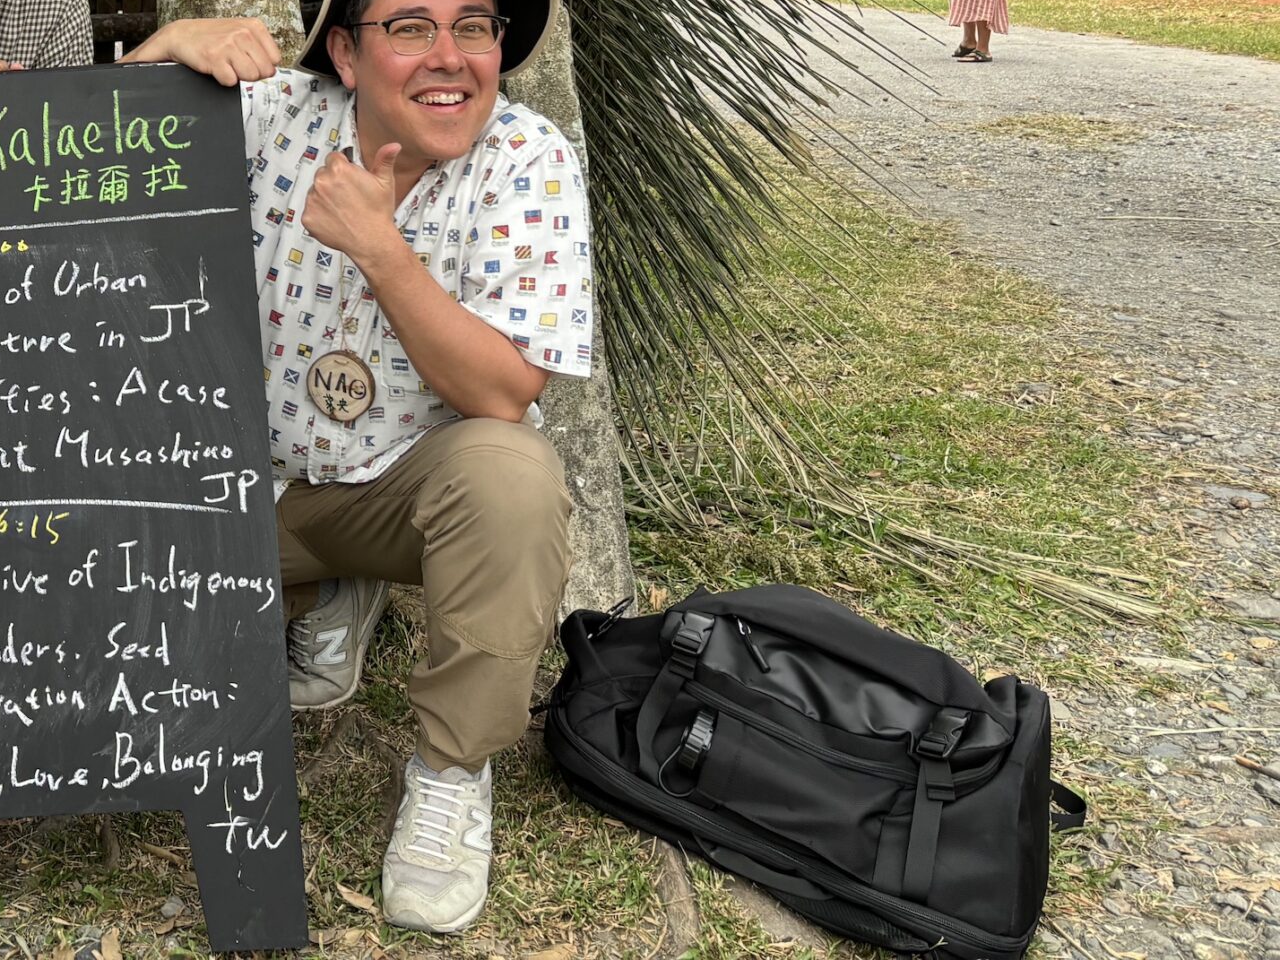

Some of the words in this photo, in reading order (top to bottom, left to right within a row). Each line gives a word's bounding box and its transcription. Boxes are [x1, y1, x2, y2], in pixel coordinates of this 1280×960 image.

[23, 157, 188, 213] 卡拉爾拉
[5, 264, 35, 305] of
[54, 259, 147, 298] Urban
[96, 320, 125, 348] in
[116, 366, 147, 406] A
[158, 380, 232, 409] case
[55, 426, 234, 468] Musashino
[199, 468, 260, 513] JP
[68, 548, 99, 589] of
[116, 539, 276, 613] Indigenous
[104, 621, 170, 666] Seed
[110, 723, 264, 802] Belonging
